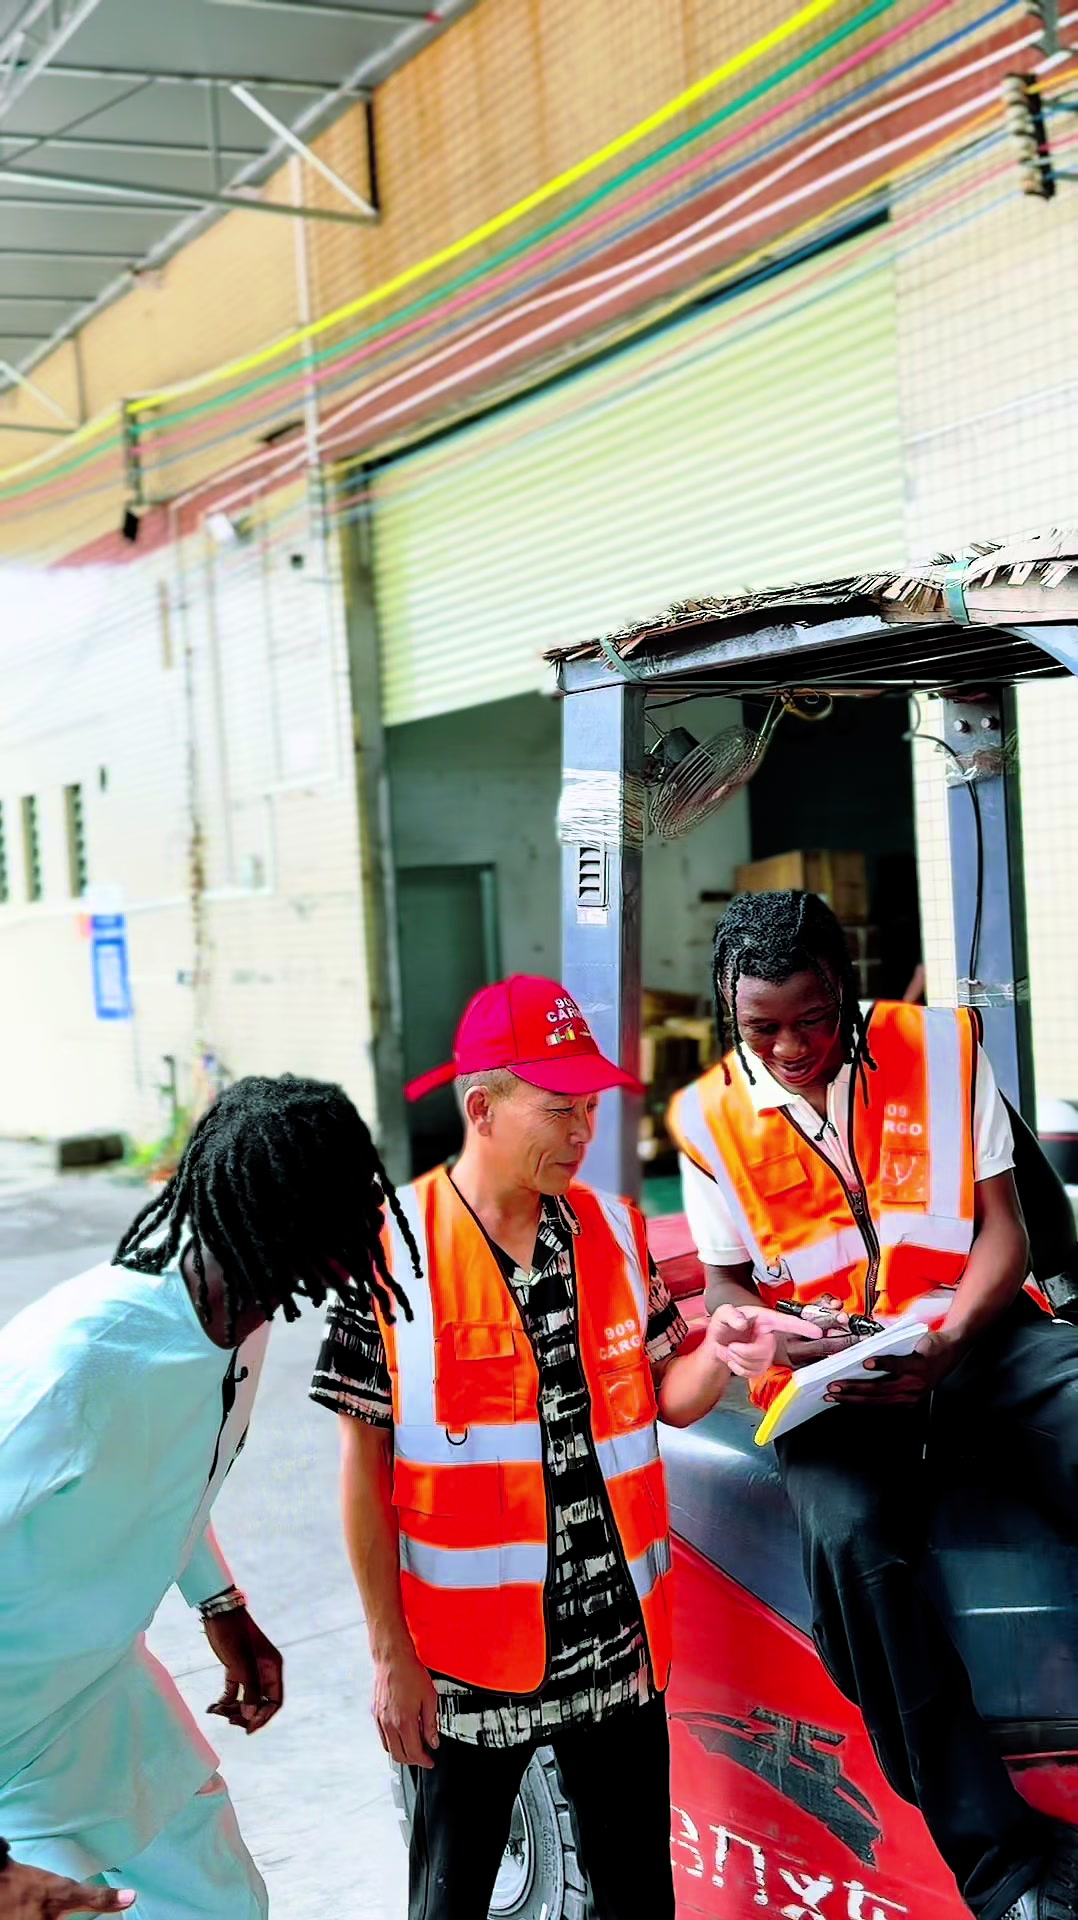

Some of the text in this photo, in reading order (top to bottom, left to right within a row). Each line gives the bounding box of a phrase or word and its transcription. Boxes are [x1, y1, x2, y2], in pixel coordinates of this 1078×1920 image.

[554, 997, 575, 1009] 90
[886, 1103, 908, 1118] 09
[883, 1120, 922, 1136] RGO
[604, 1319, 636, 1340] 909
[599, 1335, 641, 1360] CARG
